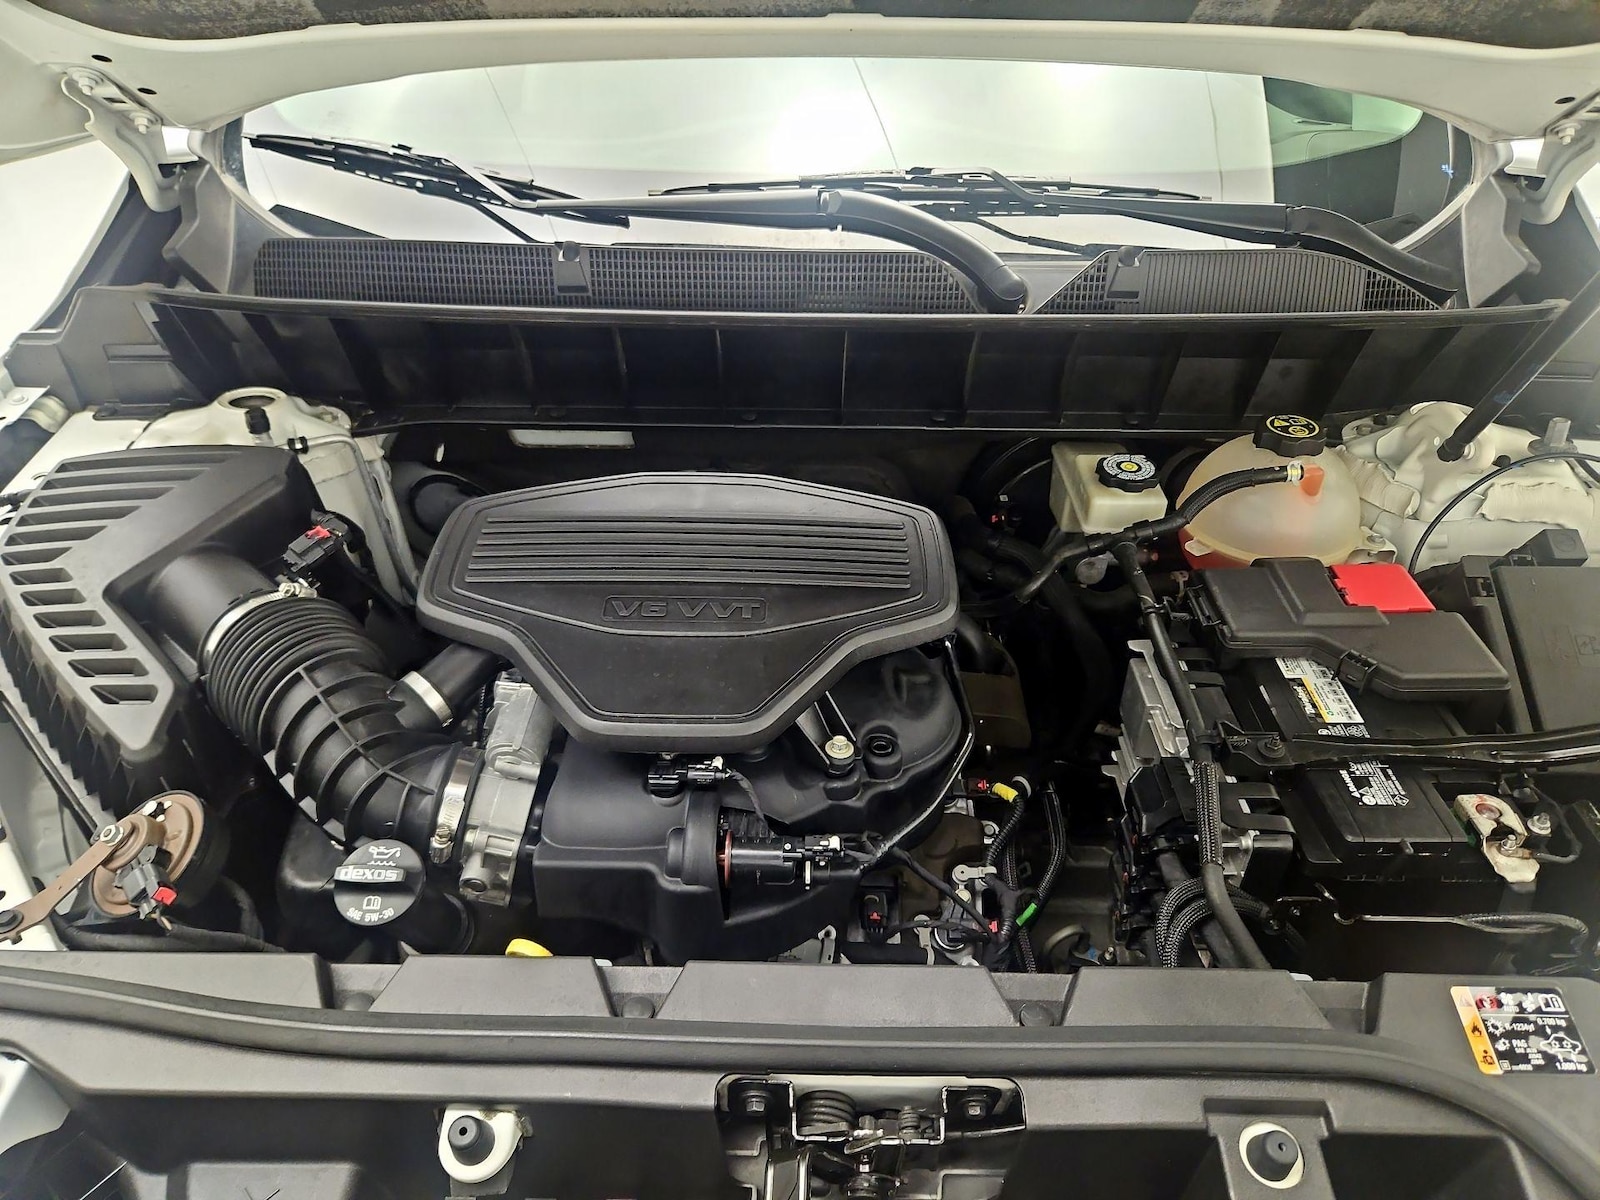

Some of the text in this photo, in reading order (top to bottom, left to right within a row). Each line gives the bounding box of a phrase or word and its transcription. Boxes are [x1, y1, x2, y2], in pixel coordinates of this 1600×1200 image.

[611, 601, 761, 618] V6 VVT
[340, 866, 400, 881] dexos
[347, 907, 395, 922] SAE 5W-30
[1511, 1039, 1528, 1048] PAG
